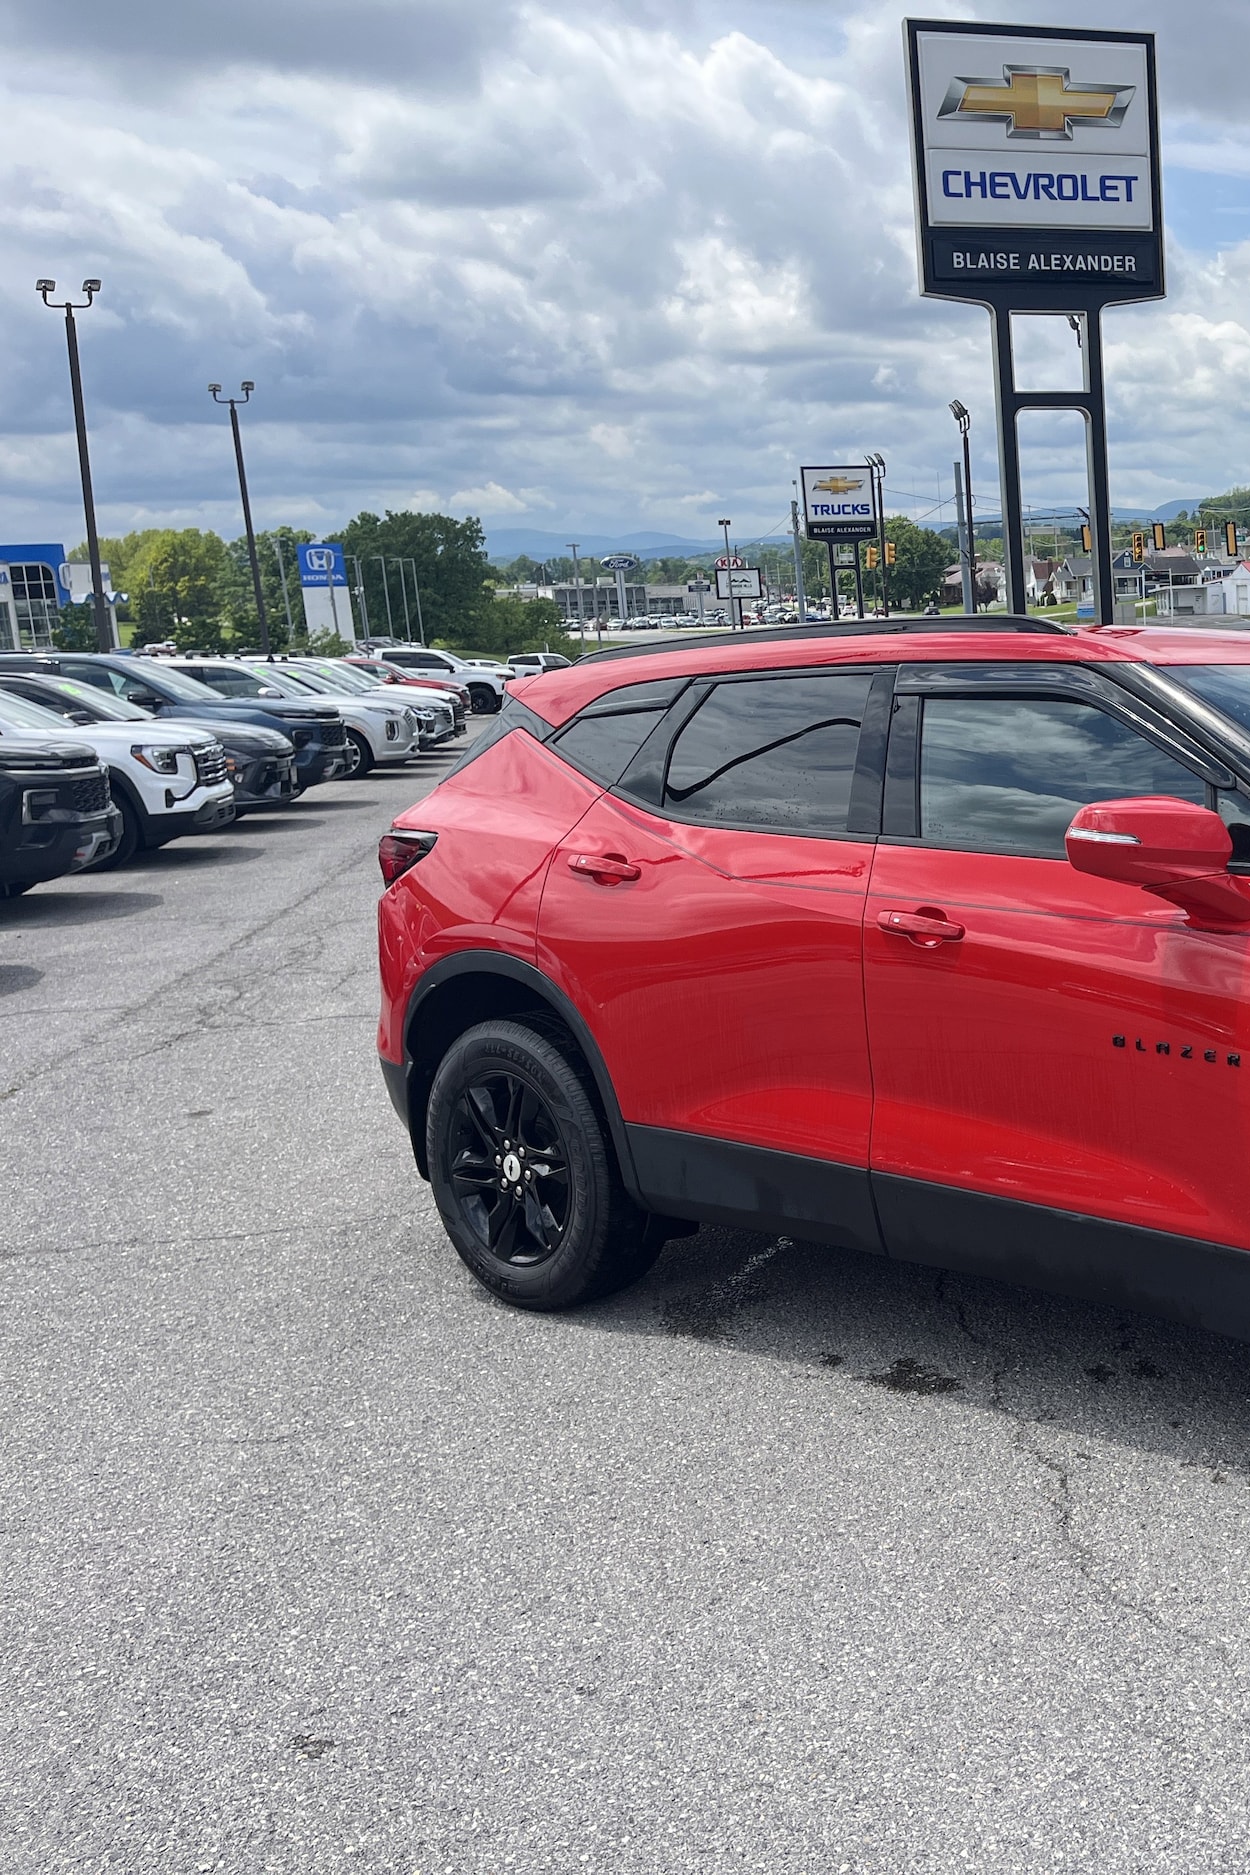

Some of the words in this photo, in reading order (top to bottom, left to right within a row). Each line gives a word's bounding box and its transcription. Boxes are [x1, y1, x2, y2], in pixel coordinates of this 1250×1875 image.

[942, 170, 1138, 202] CHEVROLET
[953, 252, 1020, 270] BLAISE
[1028, 254, 1137, 272] ALEXANDER
[811, 504, 870, 515] TRUCKS
[609, 560, 630, 568] Ford
[720, 559, 739, 567] KA
[1112, 1034, 1241, 1067] BLAZER
